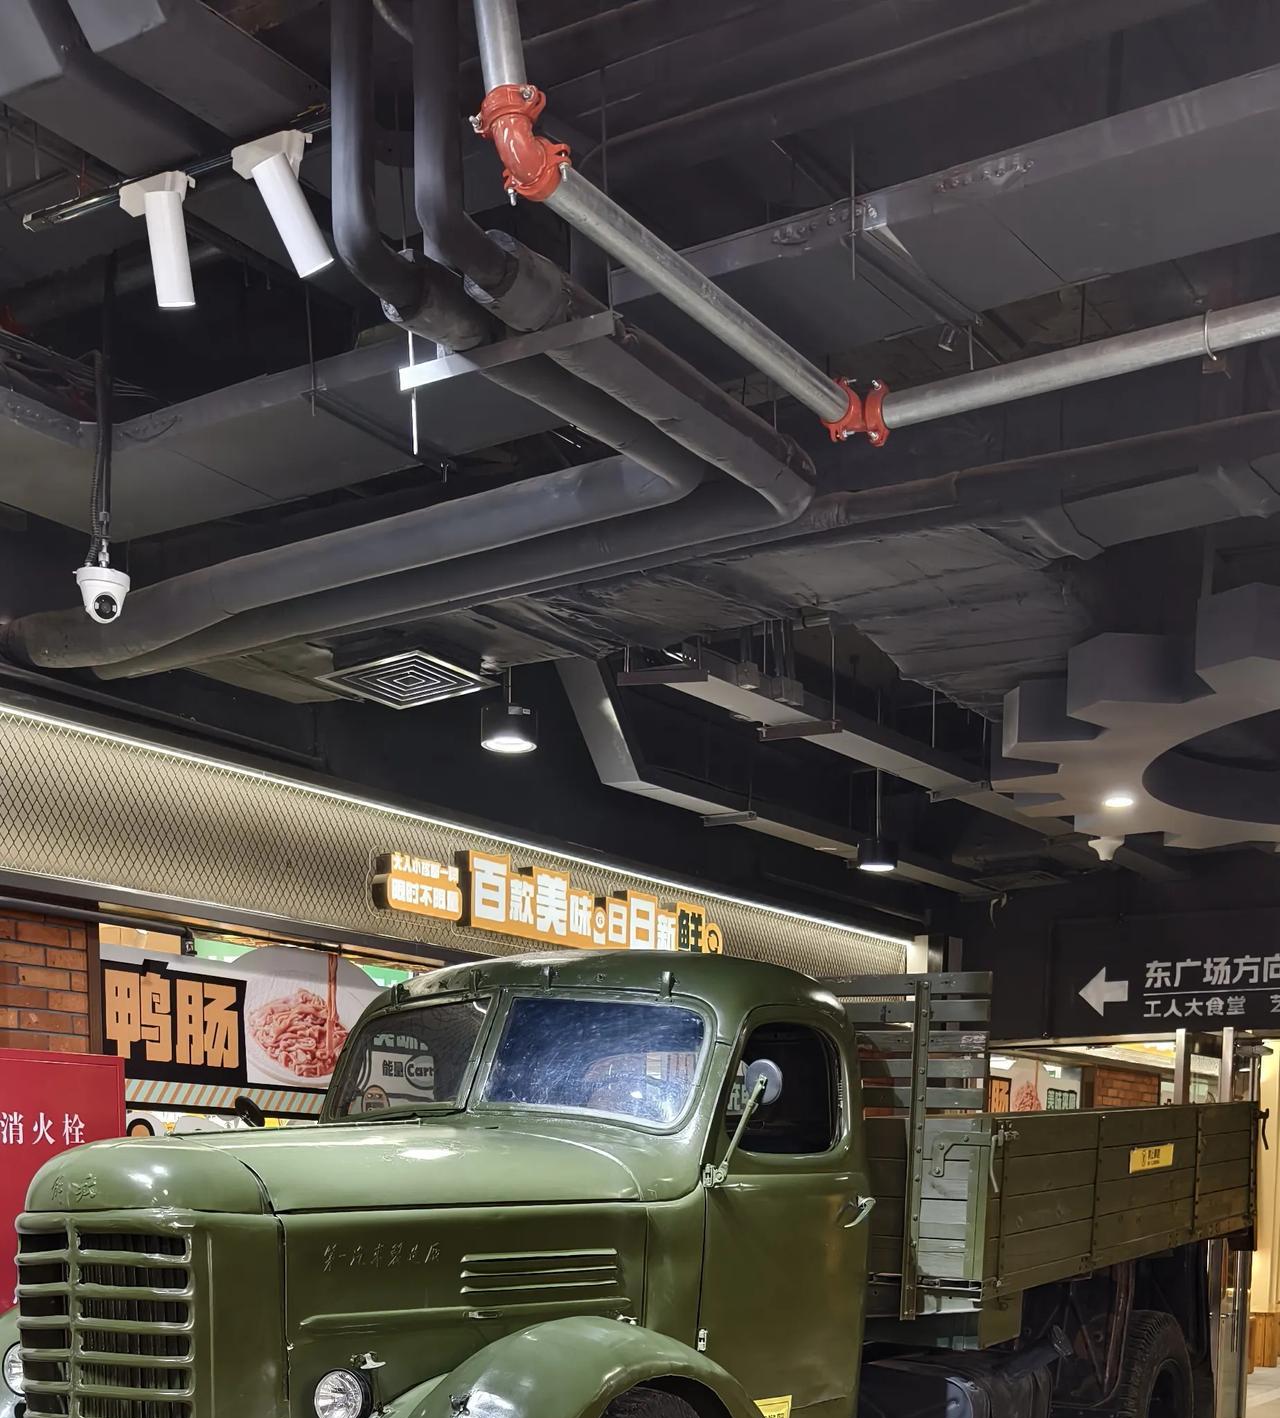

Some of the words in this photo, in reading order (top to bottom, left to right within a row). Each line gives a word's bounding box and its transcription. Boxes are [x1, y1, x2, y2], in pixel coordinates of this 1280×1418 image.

[473, 857, 592, 936] 百款美味
[608, 897, 703, 951] 日日新鲜
[1144, 953, 1280, 988] 东广场方向
[104, 968, 239, 1069] 鸭肠
[1143, 995, 1246, 1018] 工人大食堂
[0, 1112, 85, 1146] 消火栓
